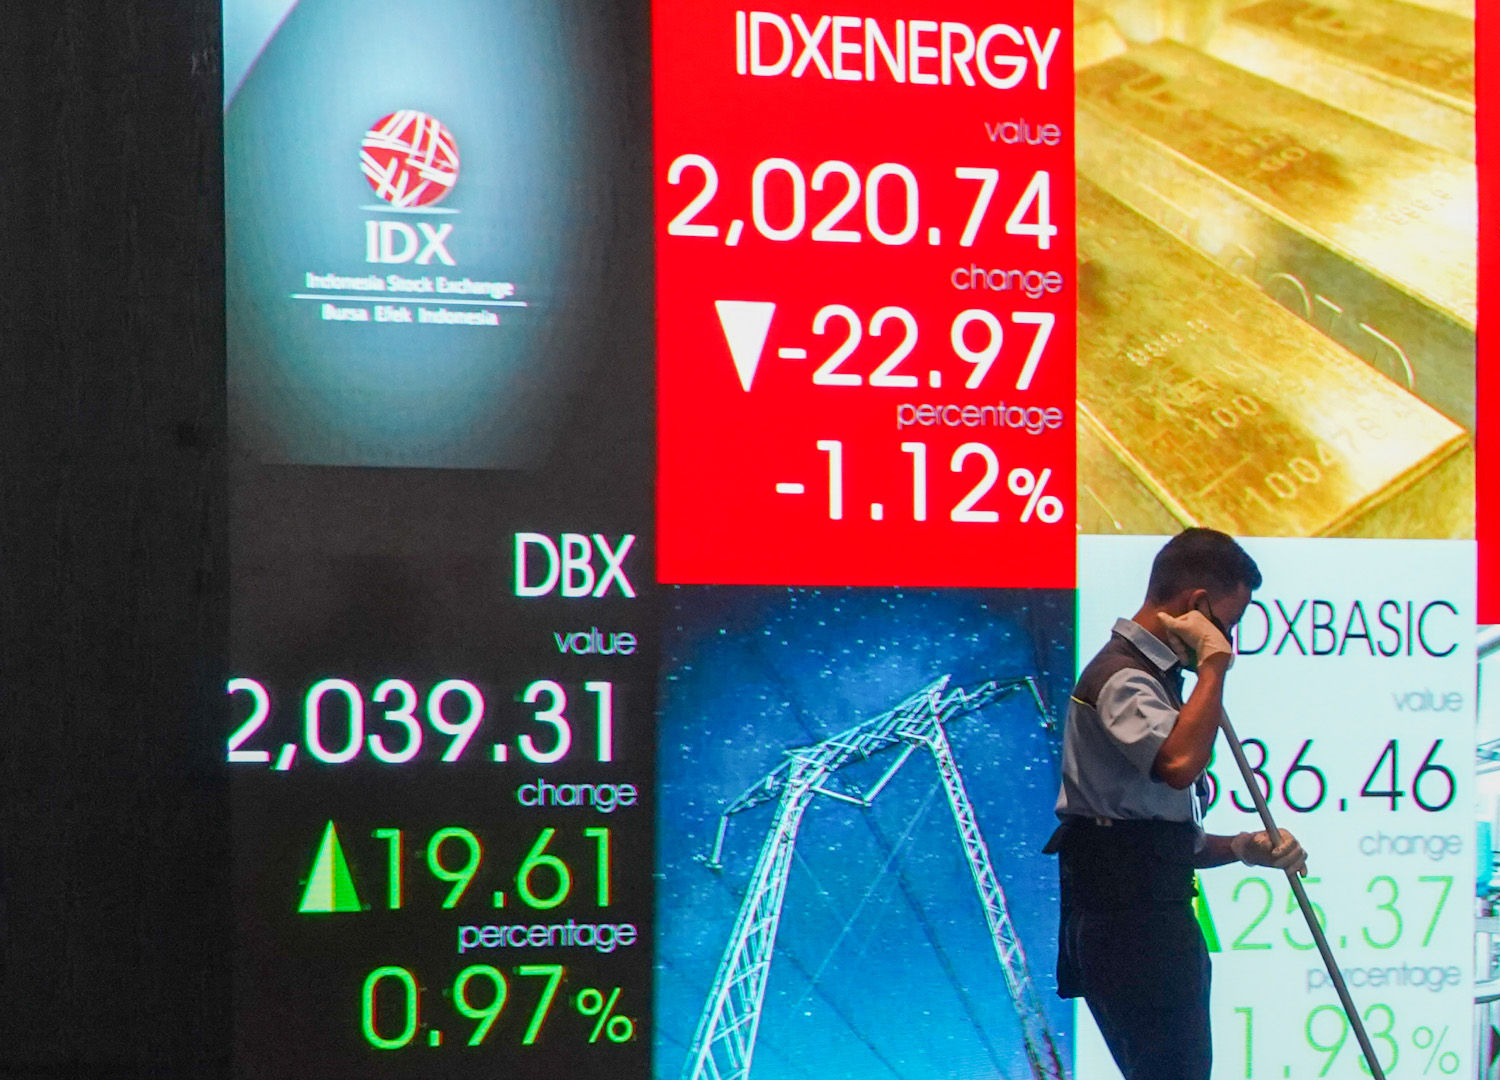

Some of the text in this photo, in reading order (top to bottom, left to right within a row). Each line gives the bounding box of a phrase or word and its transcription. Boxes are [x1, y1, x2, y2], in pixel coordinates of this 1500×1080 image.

[736, 10, 1060, 89] IDXENERGY
[985, 118, 1061, 145] value
[667, 153, 1057, 249] 2,020.74
[365, 220, 456, 266] IDX
[306, 272, 515, 299] Indonesia Stock Exchange
[951, 264, 1063, 299] change
[321, 303, 500, 326] Bursa Efek Indonesia
[778, 304, 1055, 391] -22.97
[897, 401, 1063, 435] percentage
[776, 439, 1064, 524] -1.12%
[514, 532, 636, 598] DBX
[554, 627, 637, 655] value
[1236, 599, 1459, 657] DXBASIC
[1392, 687, 1463, 713] value
[227, 678, 613, 771] 2,039.31
[517, 778, 637, 813] change
[1360, 830, 1463, 860] change
[371, 827, 613, 910] 19.61
[1231, 875, 1453, 951] 25.37
[458, 919, 637, 954] percentage
[1306, 962, 1461, 994] prcentage
[362, 964, 635, 1050] 0.97%
[1234, 1003, 1460, 1079] 1.93%
